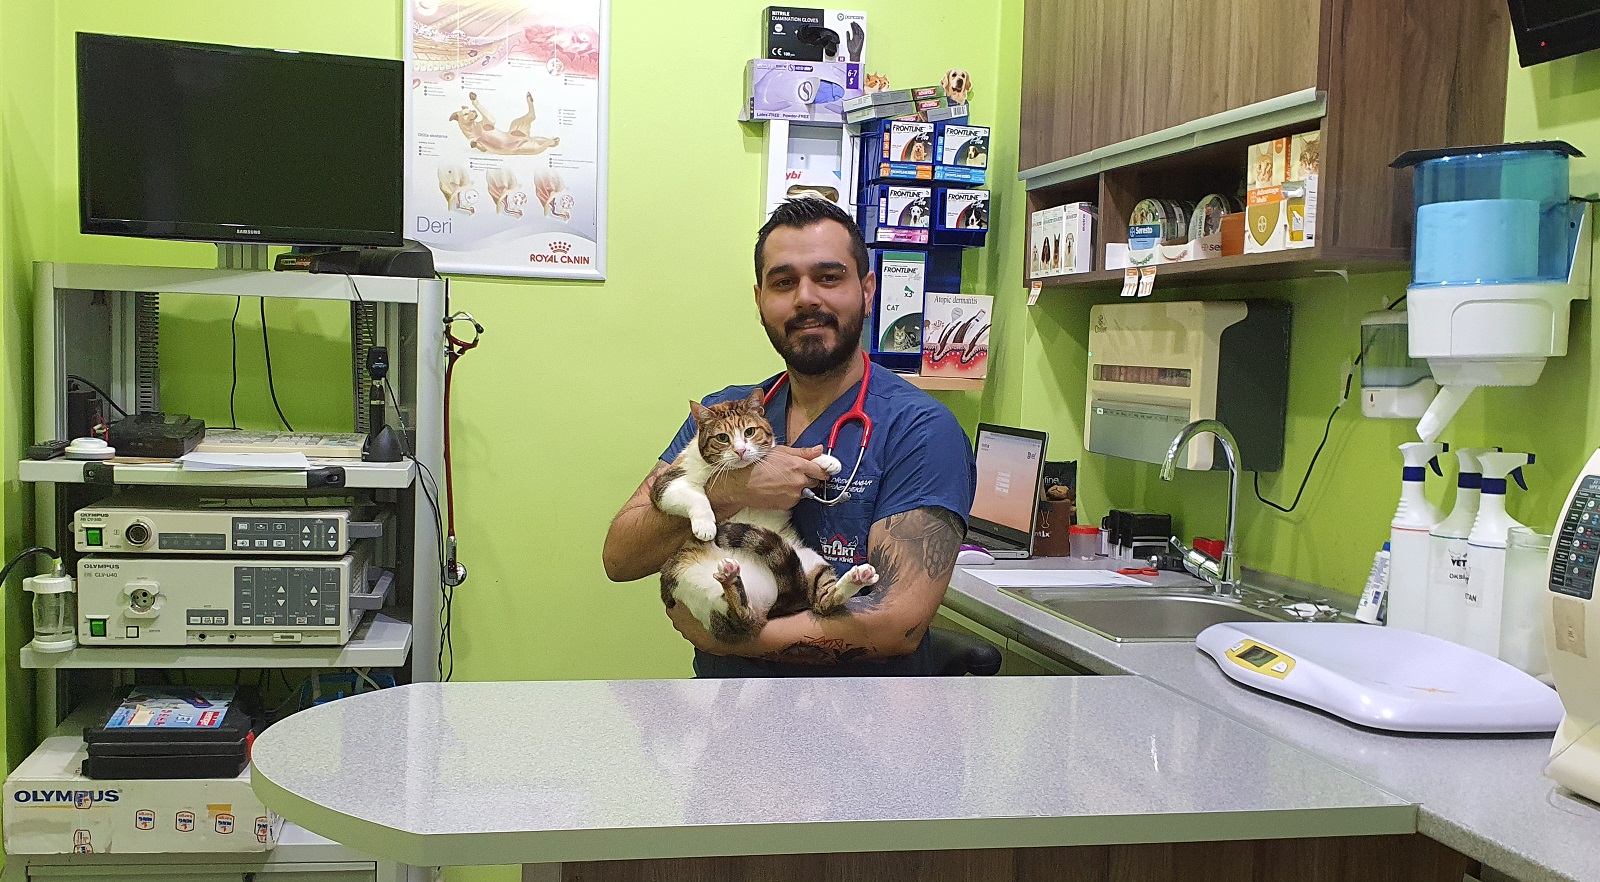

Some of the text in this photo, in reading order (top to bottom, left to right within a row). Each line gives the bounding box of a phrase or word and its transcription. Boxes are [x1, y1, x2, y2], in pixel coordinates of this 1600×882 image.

[847, 69, 858, 77] 6-7
[892, 124, 925, 132] FRONTLINE
[946, 128, 979, 136] FRONTLINE
[889, 189, 921, 197] FRONTLINE
[948, 193, 979, 201] FRONTLINE
[416, 215, 452, 234] Deri
[1135, 226, 1153, 235] Seresto
[1209, 244, 1221, 252] se
[529, 253, 590, 265] ROYAL CANIN
[883, 266, 916, 274] FRONTLINE
[934, 295, 978, 305] Atopic dermatitis
[14, 790, 120, 803] OLYMPUS
